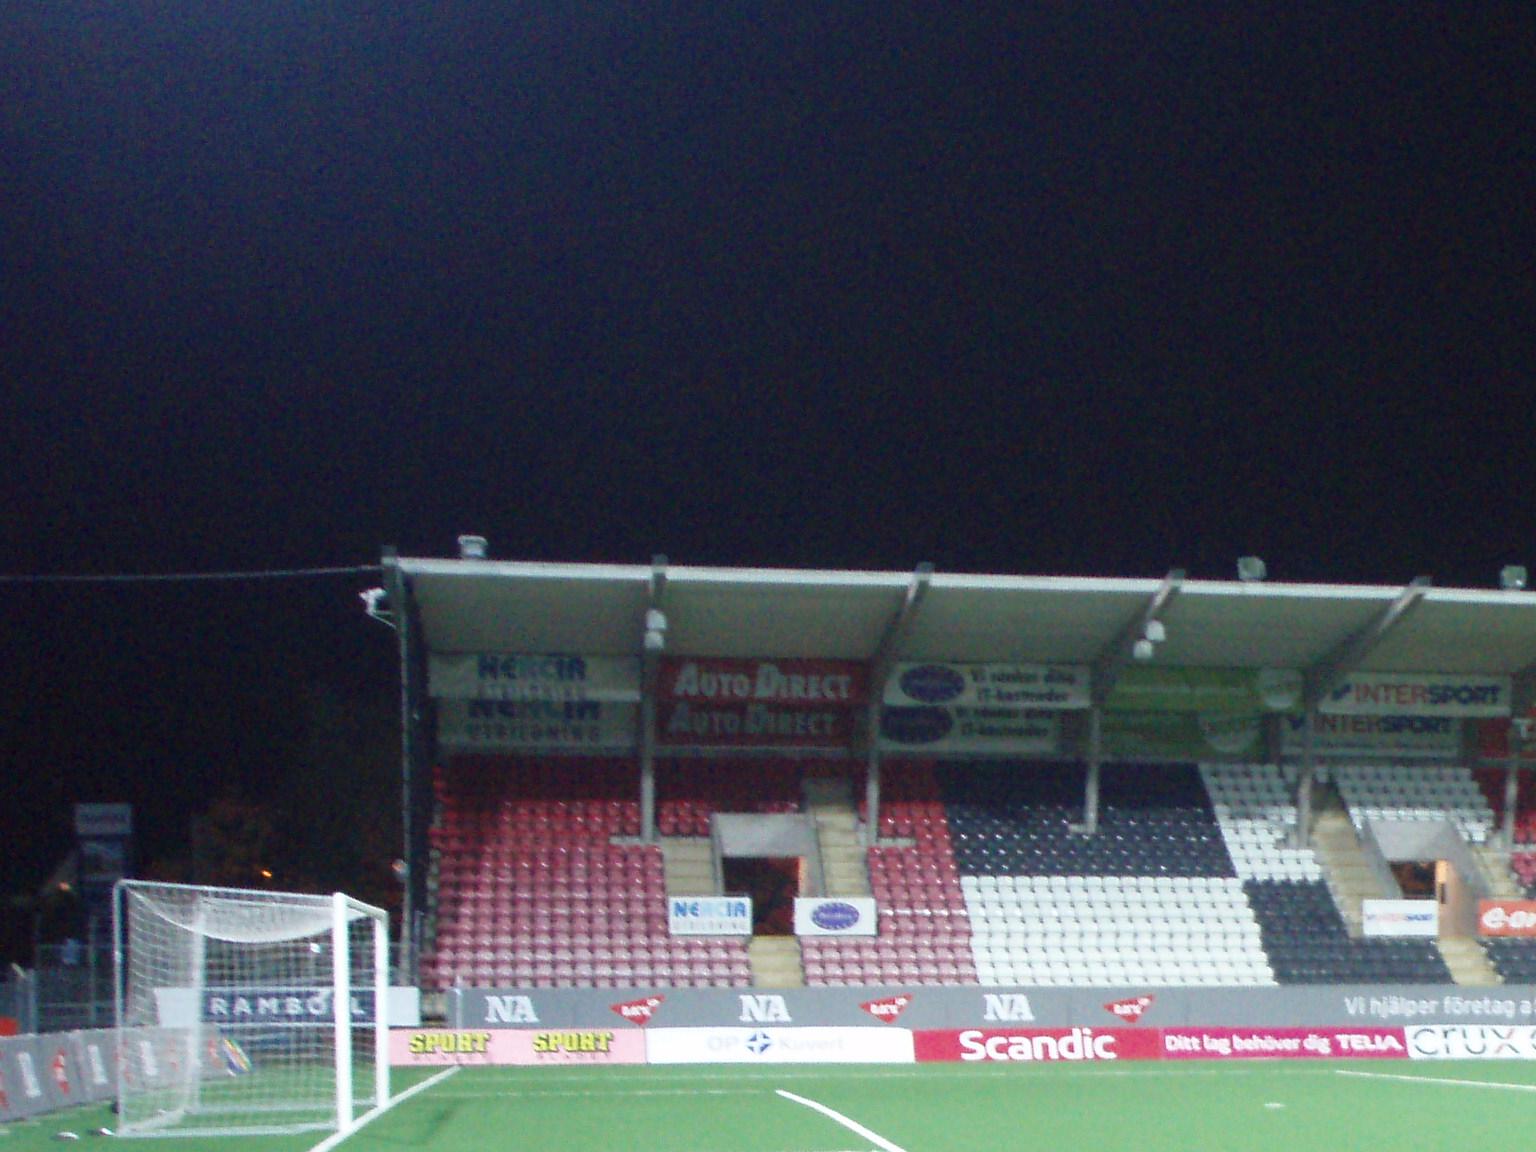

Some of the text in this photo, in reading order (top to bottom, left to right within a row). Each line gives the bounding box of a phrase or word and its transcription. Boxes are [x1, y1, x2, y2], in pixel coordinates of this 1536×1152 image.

[1355, 684, 1499, 705] INTERSPORT
[1313, 714, 1454, 734] INTERSPORT
[674, 902, 746, 918] NEIA
[485, 996, 538, 1023] NA
[739, 994, 792, 1022] NA
[984, 994, 1035, 1021] NA
[1344, 997, 1366, 1015] Vi
[1369, 996, 1438, 1019] hjälper
[1444, 996, 1515, 1018] företag
[409, 1032, 491, 1053] SPORT
[533, 1031, 613, 1053] SPORT
[959, 1028, 1117, 1060] Scandic
[1165, 1035, 1201, 1051] Ditt
[1203, 1034, 1232, 1055] lag
[1232, 1034, 1300, 1051] behöver
[1303, 1033, 1331, 1054] dig
